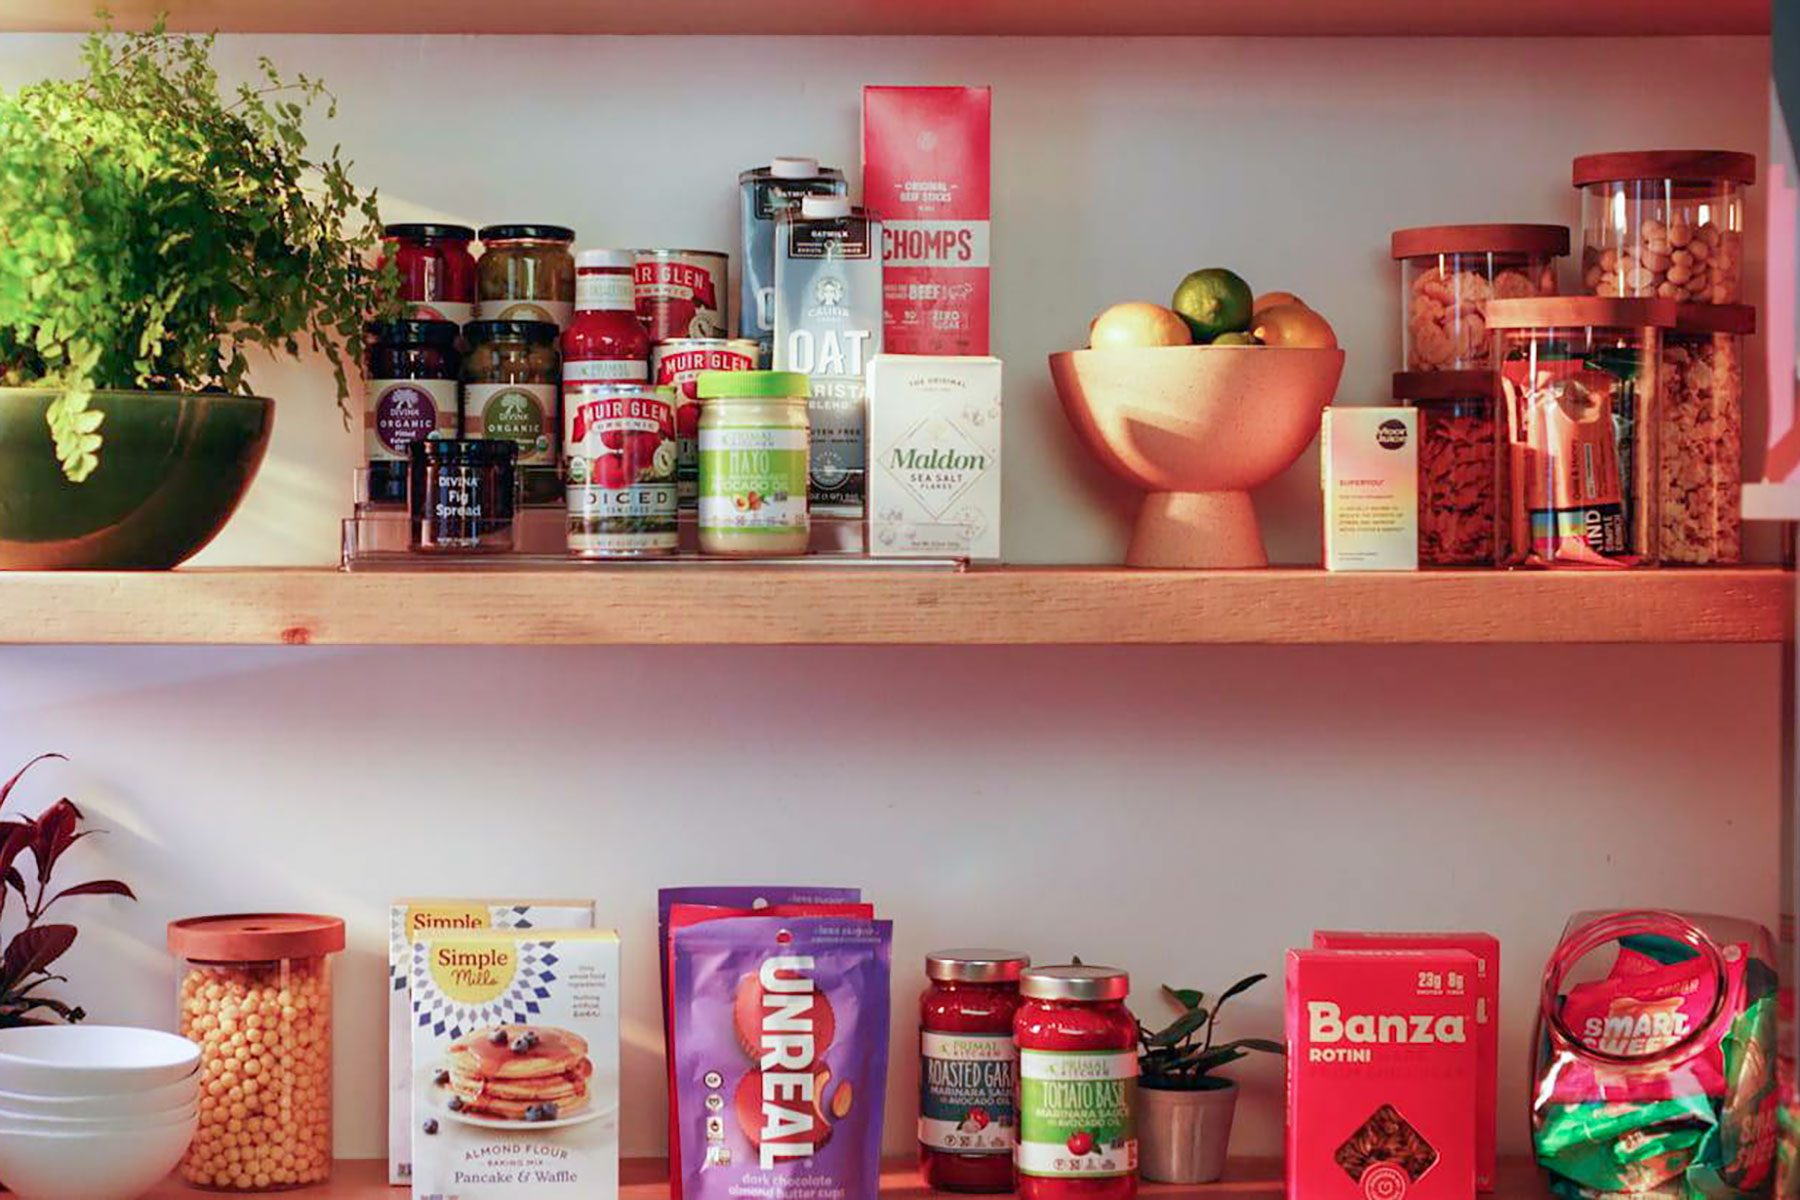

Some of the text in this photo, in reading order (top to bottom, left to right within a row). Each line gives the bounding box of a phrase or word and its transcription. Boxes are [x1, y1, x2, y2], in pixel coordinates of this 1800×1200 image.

[882, 229, 972, 261] CHOMPS
[658, 267, 705, 289] GLEN
[787, 328, 871, 375] OAT
[665, 354, 750, 376] MUIR GLEN
[583, 401, 668, 422] MUIR GLEN
[380, 419, 432, 429] ORGANIC
[488, 423, 540, 433] ORGANIC
[889, 447, 986, 471] Maldon
[438, 476, 479, 488] DIVINA
[911, 474, 963, 483] SEA SALT
[449, 490, 470, 504] Fig
[436, 503, 482, 517] Spread
[413, 913, 482, 929] Simple
[438, 949, 508, 970] Simple
[450, 968, 498, 986] Mills
[1418, 971, 1464, 990] 23g 8g
[1307, 1001, 1467, 1044] Banza
[1583, 1011, 1691, 1038] SMART
[953, 1040, 997, 1051] PRIMAL
[758, 955, 816, 1171] UNREAL
[1309, 1048, 1371, 1063] ROTINI
[928, 1059, 981, 1088] ROASTED
[930, 1086, 986, 1097] MARINARA
[1042, 1080, 1093, 1108] TOMATO
[949, 1096, 994, 1105] AVOCADO
[464, 1144, 569, 1161] ALMOND FLOUR
[527, 1159, 544, 1167] MIX
[454, 1169, 578, 1184] Pancake & Waffle
[742, 1173, 832, 1186] dark chocolate
[728, 1184, 774, 1198] almond
[776, 1186, 816, 1199] butter
